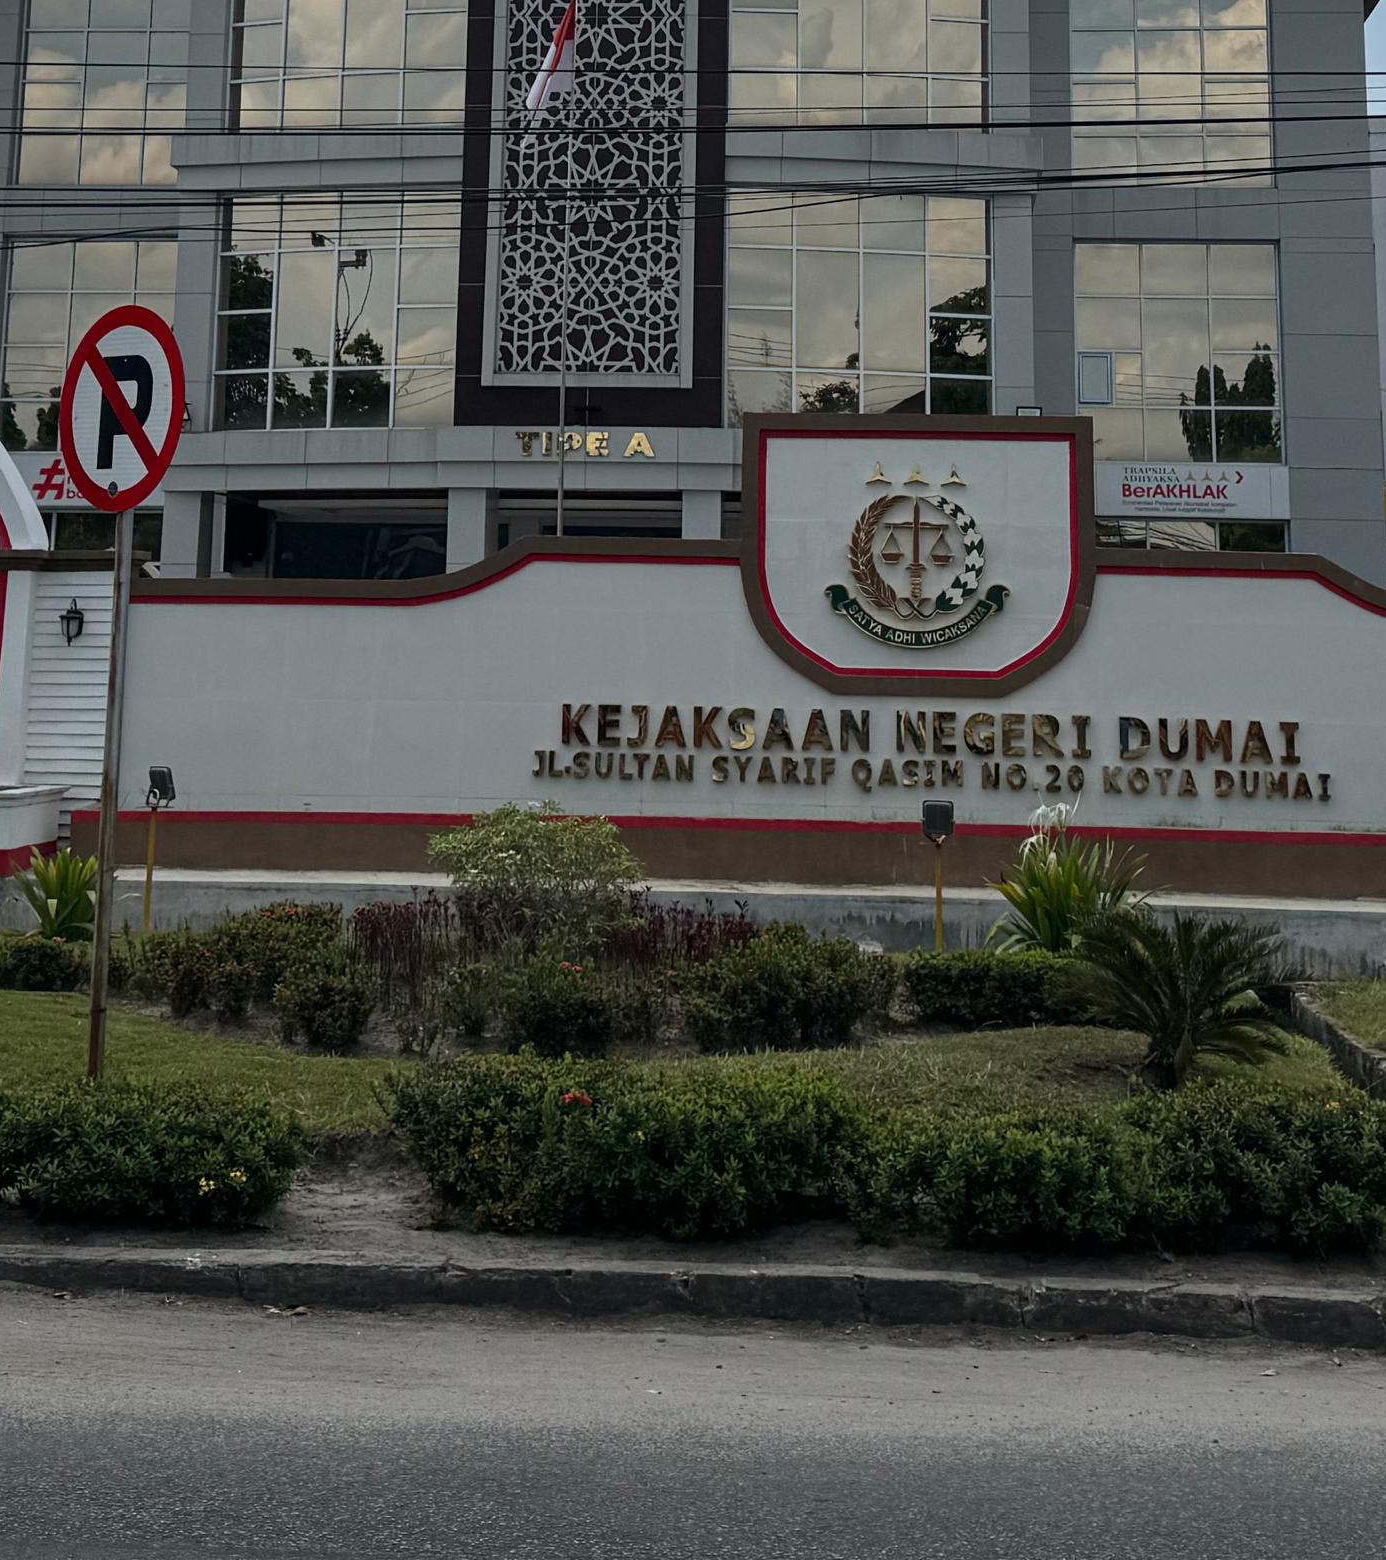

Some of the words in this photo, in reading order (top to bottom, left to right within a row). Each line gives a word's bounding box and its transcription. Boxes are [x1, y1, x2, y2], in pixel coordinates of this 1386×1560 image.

[97, 354, 154, 470] P
[515, 431, 610, 457] TIPE
[623, 431, 656, 457] A
[1122, 483, 1229, 500] BerAKHLAK
[848, 605, 882, 636] SATYA
[885, 630, 916, 644] ADHI
[920, 605, 989, 644] WICAKSANA
[561, 703, 870, 753] KEJAKSAAN
[896, 709, 1092, 759] NEGERI
[1118, 716, 1301, 765] DUMAI
[712, 755, 836, 785] SYARIF
[851, 758, 963, 792] QASIM
[1102, 765, 1199, 797] KOTA
[1214, 769, 1332, 802] DUMAI
